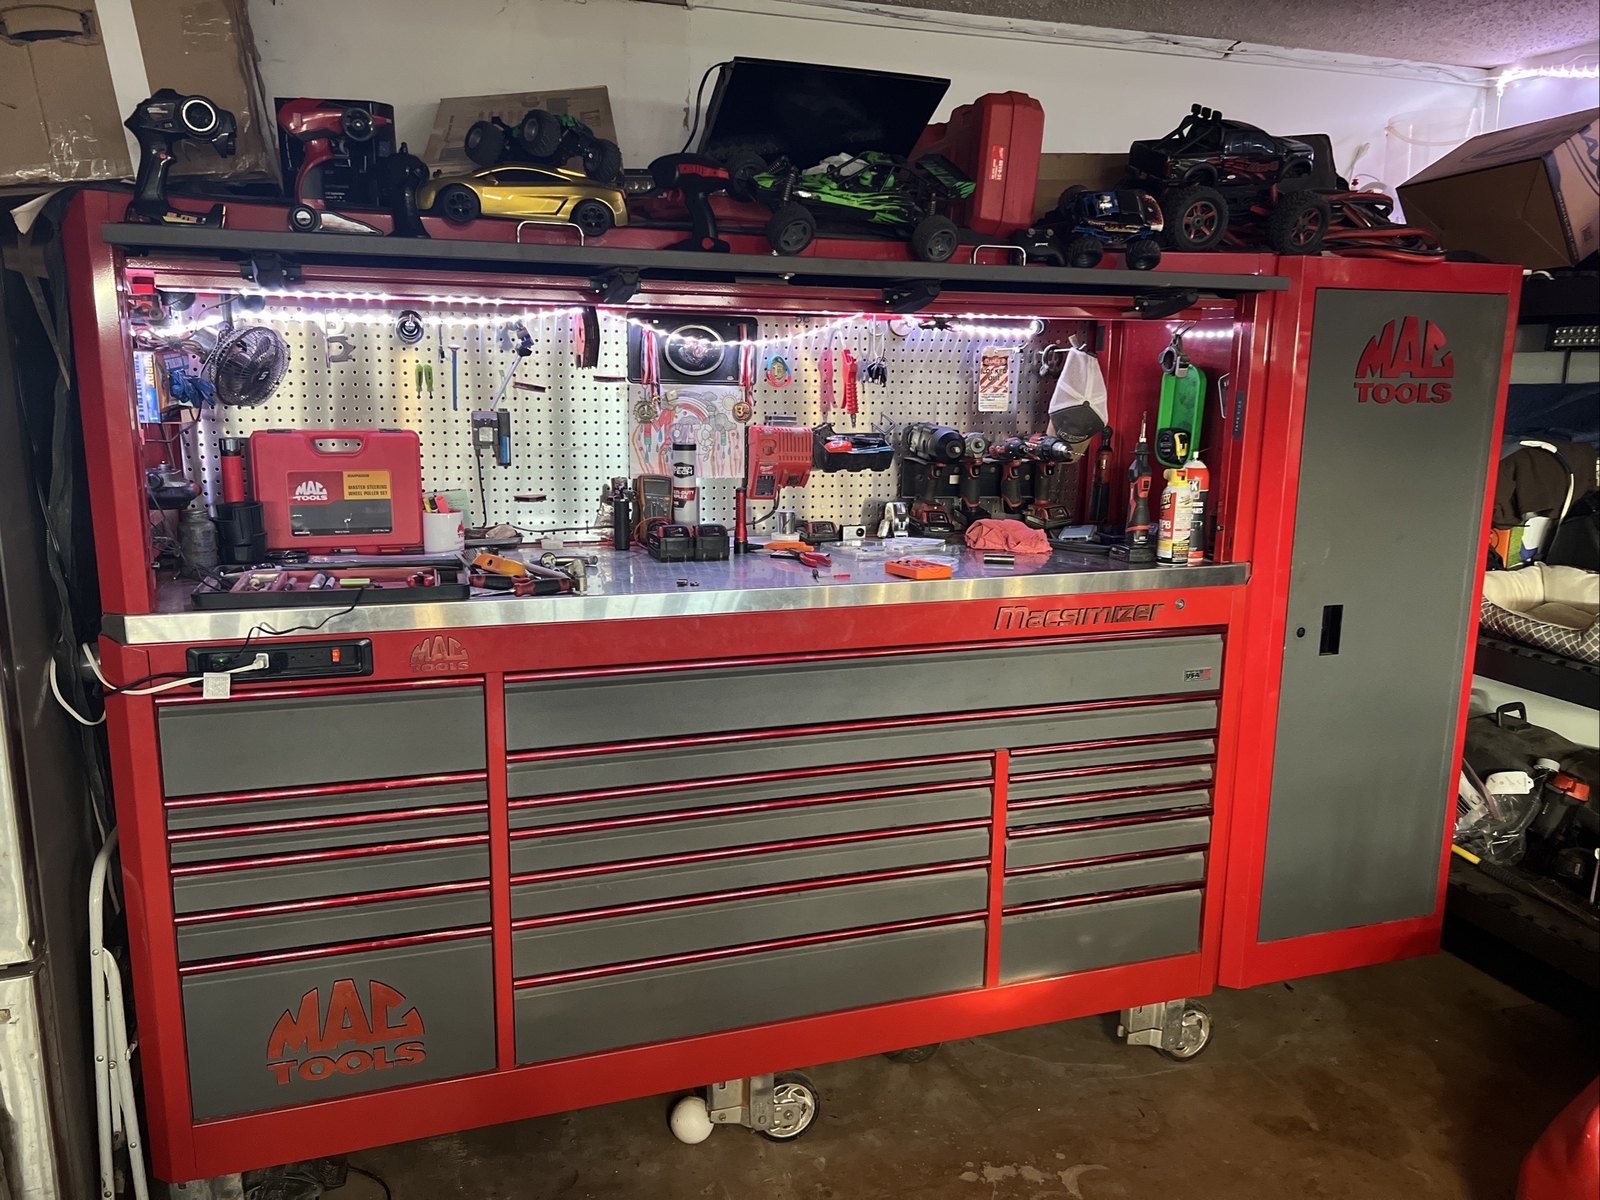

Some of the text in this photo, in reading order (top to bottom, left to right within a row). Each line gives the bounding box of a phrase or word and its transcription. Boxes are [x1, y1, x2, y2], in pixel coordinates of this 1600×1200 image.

[1355, 315, 1454, 378] MAC
[1354, 382, 1452, 404] TOOLS
[295, 481, 328, 495] MAC
[993, 603, 1165, 630] Macsimizer
[411, 635, 469, 662] MAC
[410, 661, 469, 672] TOOLS
[267, 978, 425, 1059] MAC
[266, 1041, 426, 1085] TOOLS
